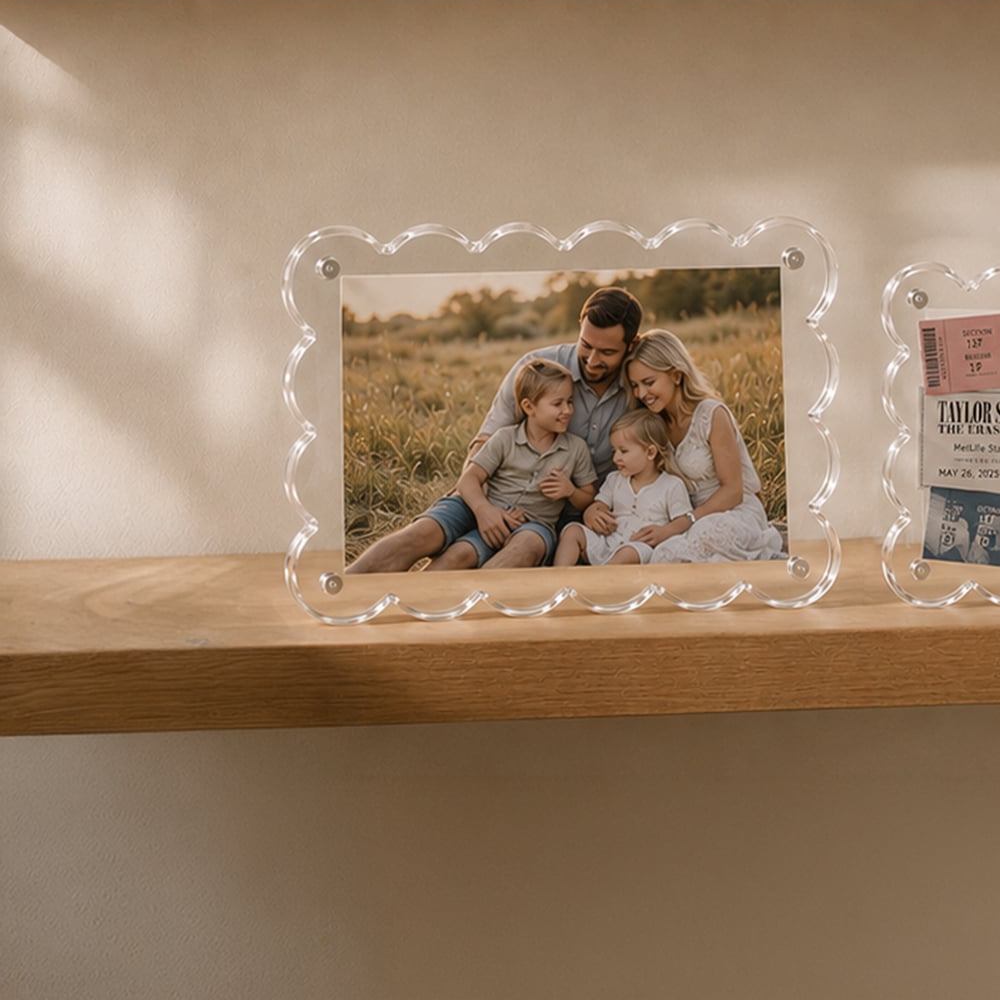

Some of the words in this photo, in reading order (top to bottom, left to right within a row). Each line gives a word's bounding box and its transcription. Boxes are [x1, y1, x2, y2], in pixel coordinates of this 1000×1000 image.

[937, 400, 992, 424] TAYLOR
[937, 424, 965, 435] THE
[968, 424, 1000, 436] ERAS
[938, 468, 959, 478] MAY
[961, 468, 976, 480] 26,
